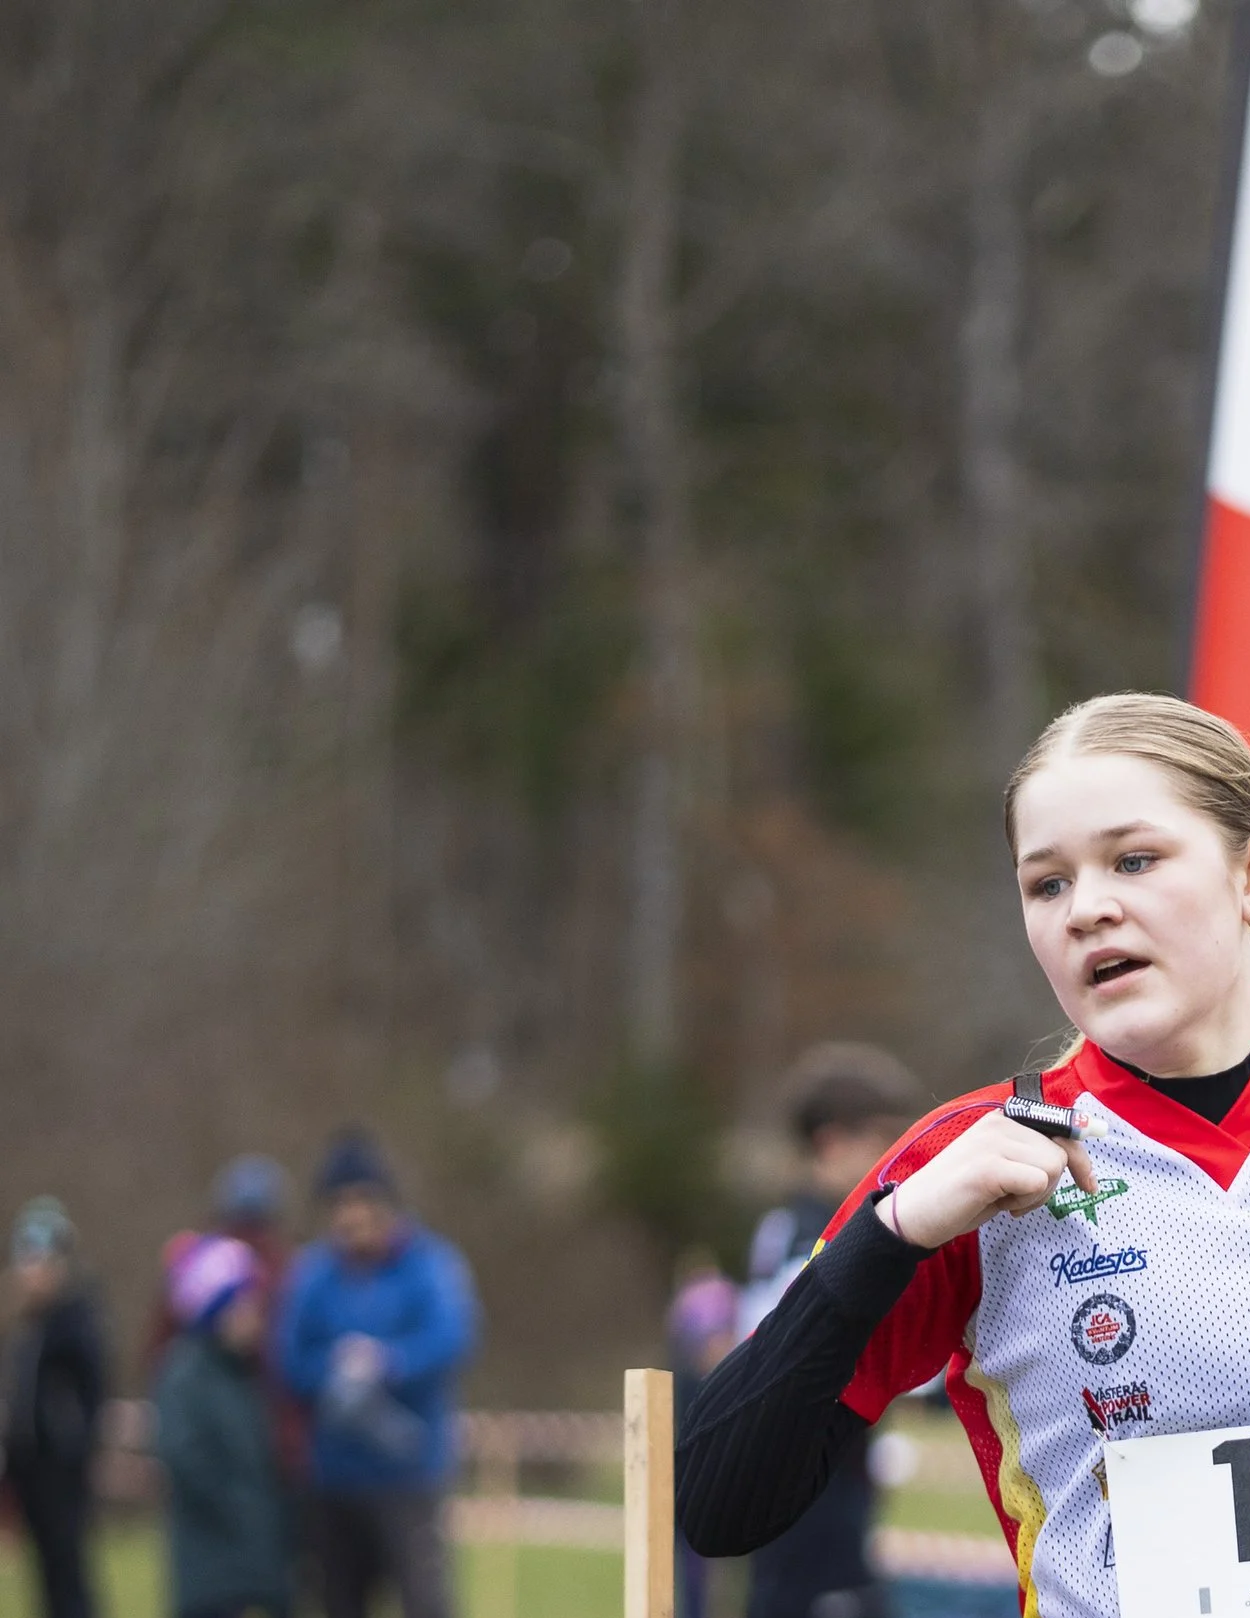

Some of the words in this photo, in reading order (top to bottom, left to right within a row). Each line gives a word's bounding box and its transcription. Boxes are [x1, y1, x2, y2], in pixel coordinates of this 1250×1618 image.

[1050, 1243, 1147, 1288] Kadesjös
[1091, 1313, 1112, 1326] ICA
[1092, 1380, 1148, 1402] VÄSTERÅS
[1102, 1391, 1152, 1413] POWER
[1106, 1406, 1153, 1431] TRAIL
